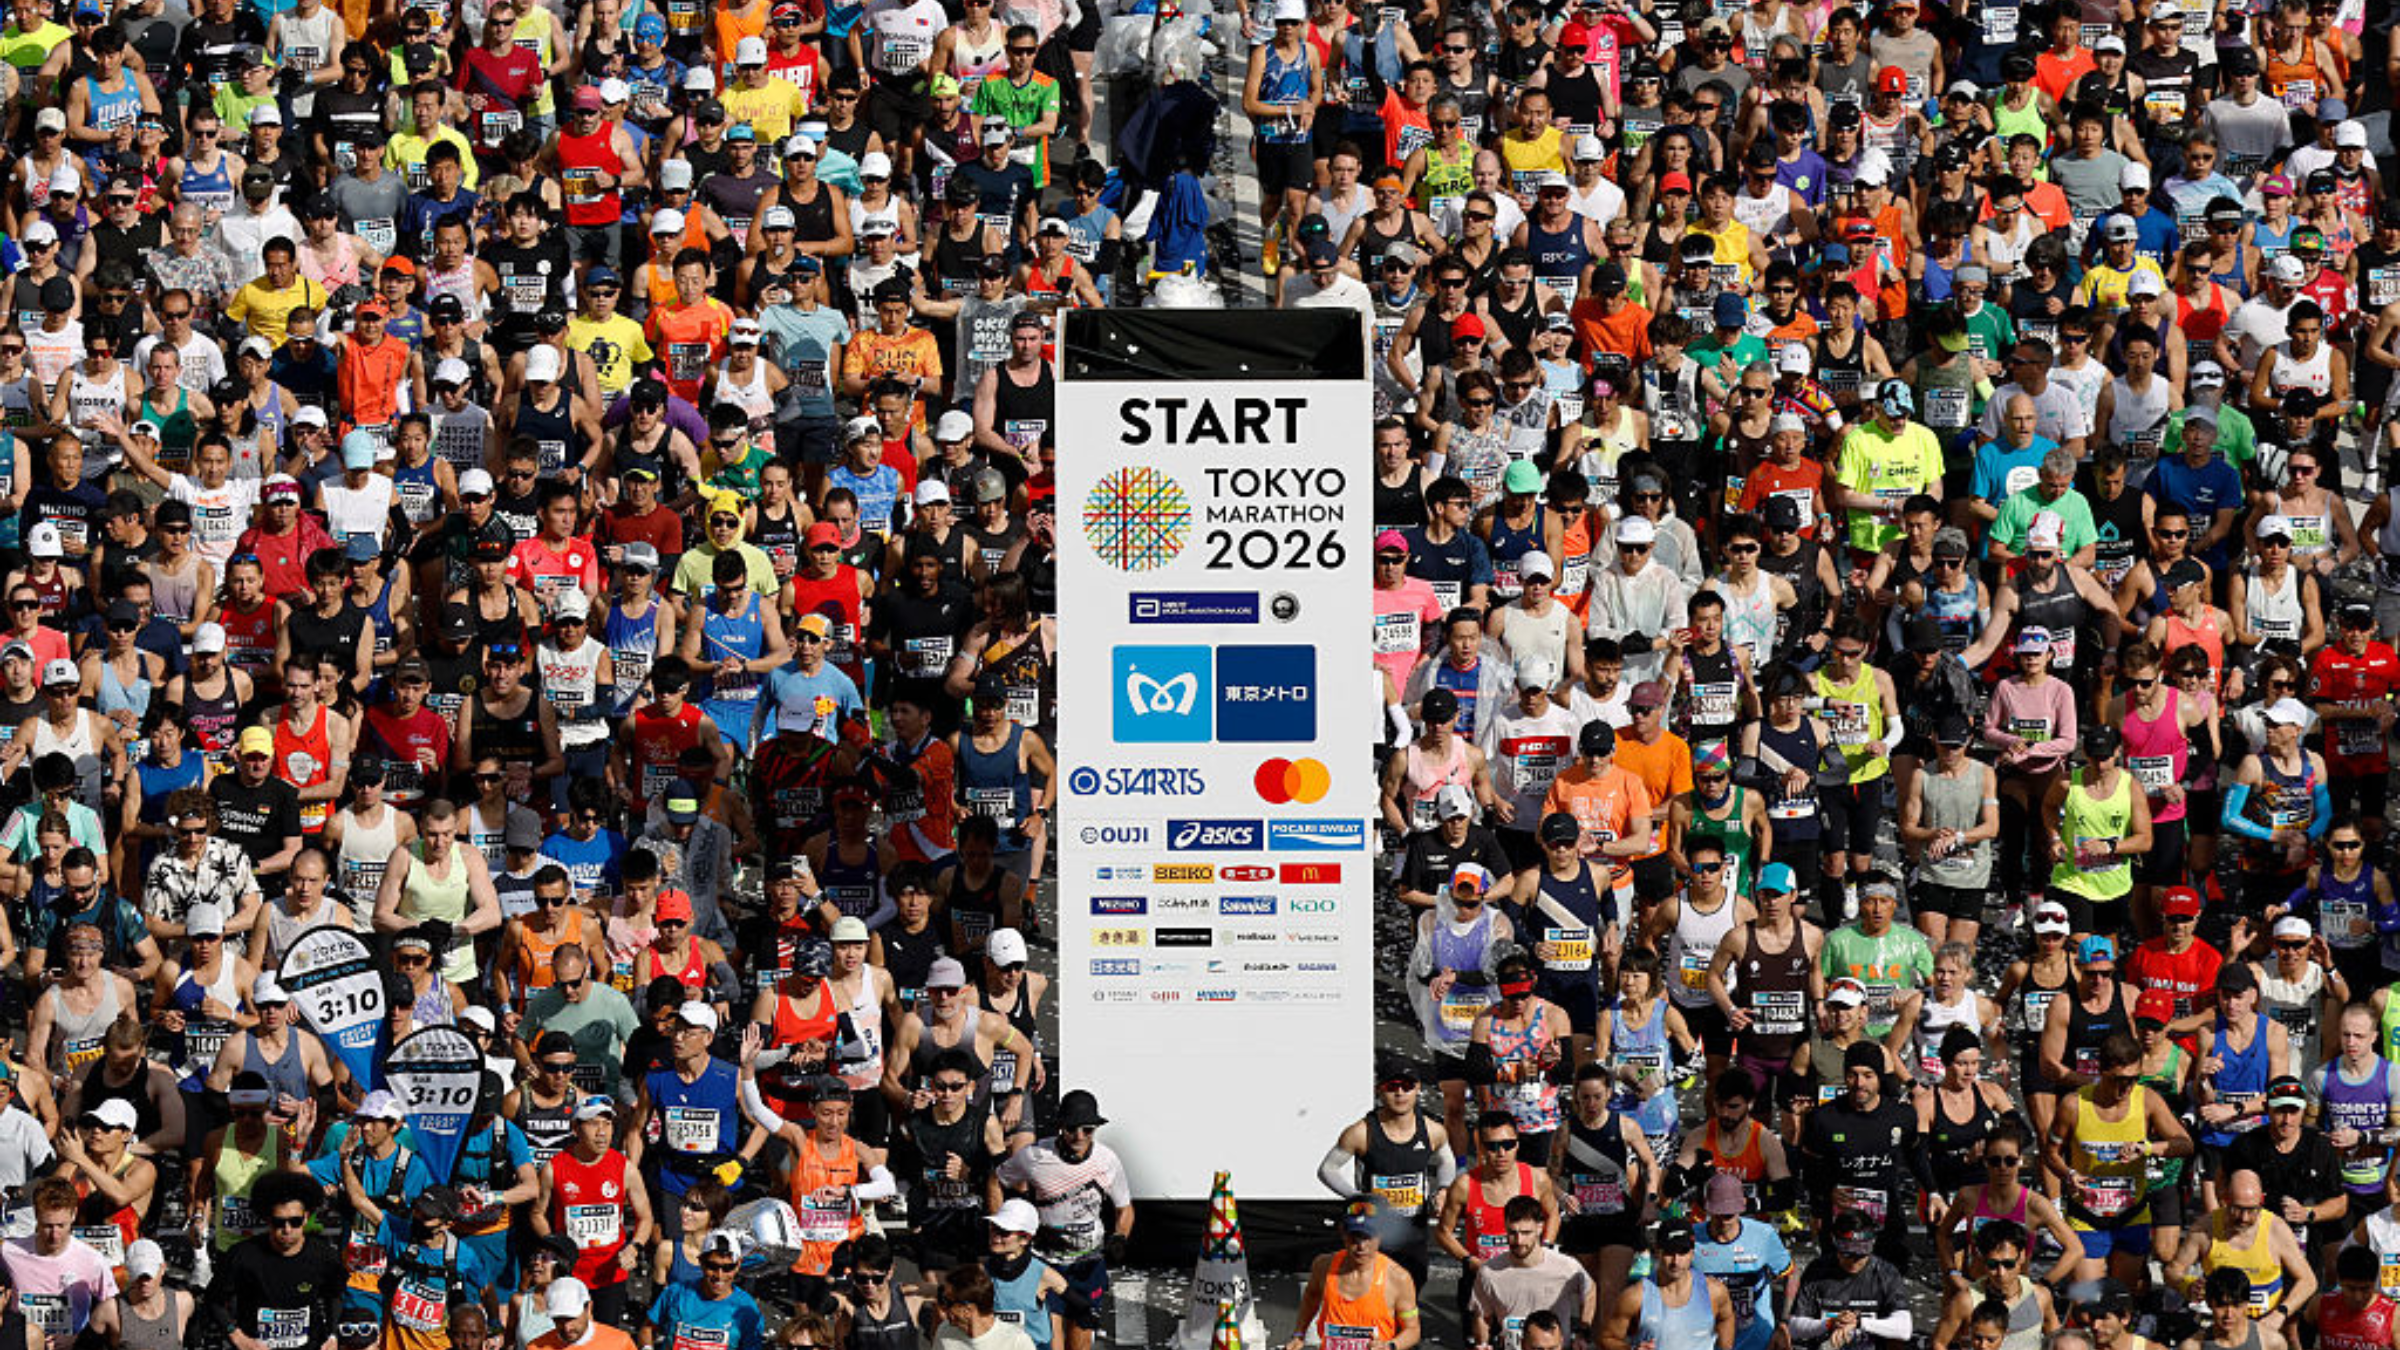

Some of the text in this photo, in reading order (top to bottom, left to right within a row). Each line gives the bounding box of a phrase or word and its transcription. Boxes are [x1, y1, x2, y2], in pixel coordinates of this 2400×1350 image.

[1120, 398, 1307, 445] START
[1205, 468, 1346, 497] TOKYO
[1207, 506, 1344, 523] MARATHON
[1206, 530, 1346, 570] 2026
[1225, 685, 1308, 702] 東京メトロ
[1101, 827, 1149, 842] OUJI
[1200, 826, 1254, 845] asics
[1272, 825, 1359, 833] POCARI SWEAT
[1155, 868, 1212, 880] SEIKO
[318, 988, 379, 1025] 3:10
[407, 1087, 473, 1107] 3:10
[1196, 1279, 1247, 1297] TOKYO
